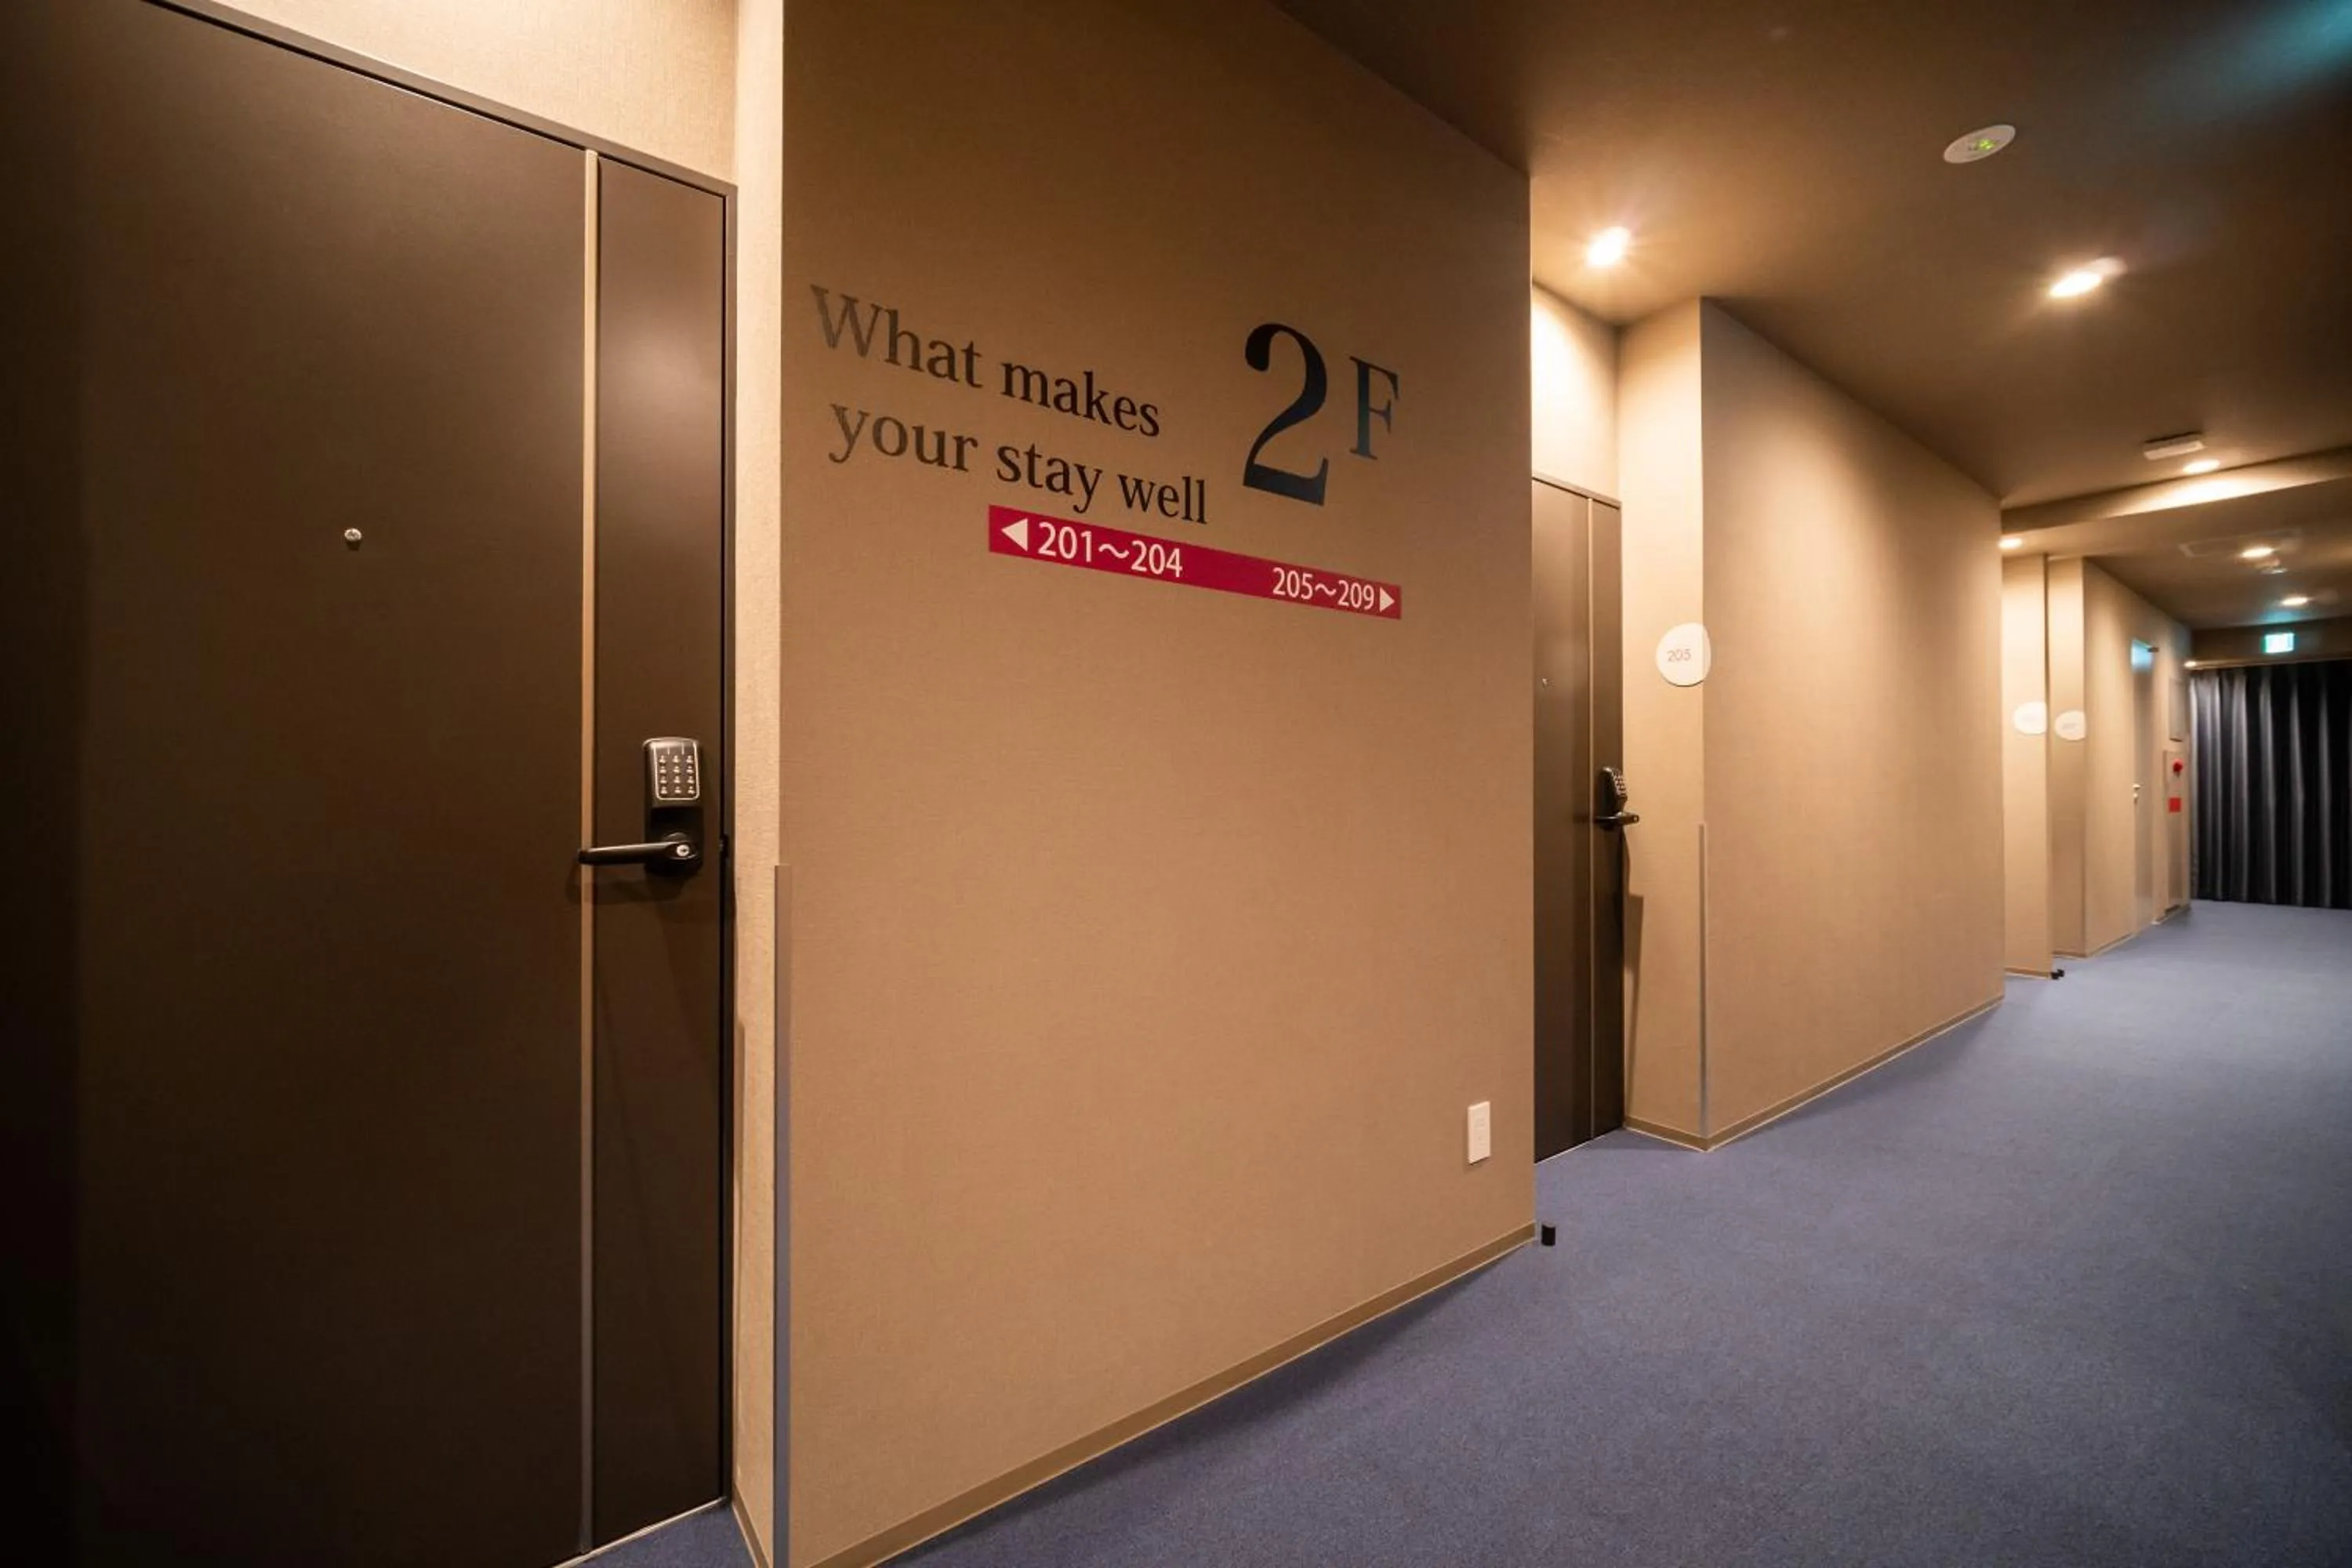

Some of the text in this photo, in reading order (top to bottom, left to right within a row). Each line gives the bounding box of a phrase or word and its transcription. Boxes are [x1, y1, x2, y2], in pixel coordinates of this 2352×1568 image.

[810, 284, 1160, 437] What makes
[828, 402, 1208, 524] your stay well
[1667, 648, 1692, 662] 205
